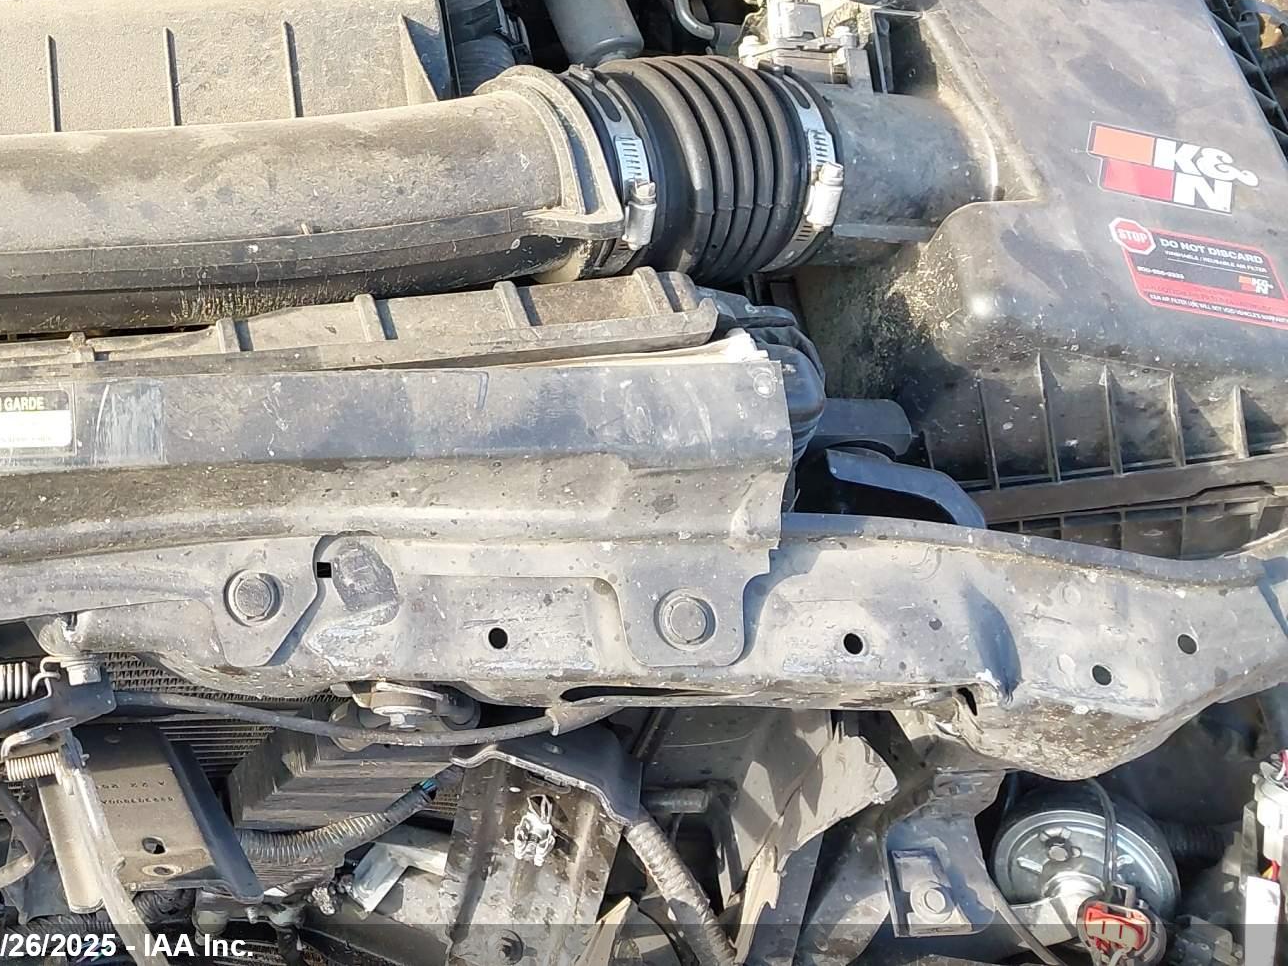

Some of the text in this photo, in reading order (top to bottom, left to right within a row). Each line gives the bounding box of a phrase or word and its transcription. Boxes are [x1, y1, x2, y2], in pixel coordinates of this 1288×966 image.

[1117, 228, 1147, 244] STOP
[1159, 238, 1263, 264] DO NOT DISCARD
[4, 396, 45, 411] GARDE
